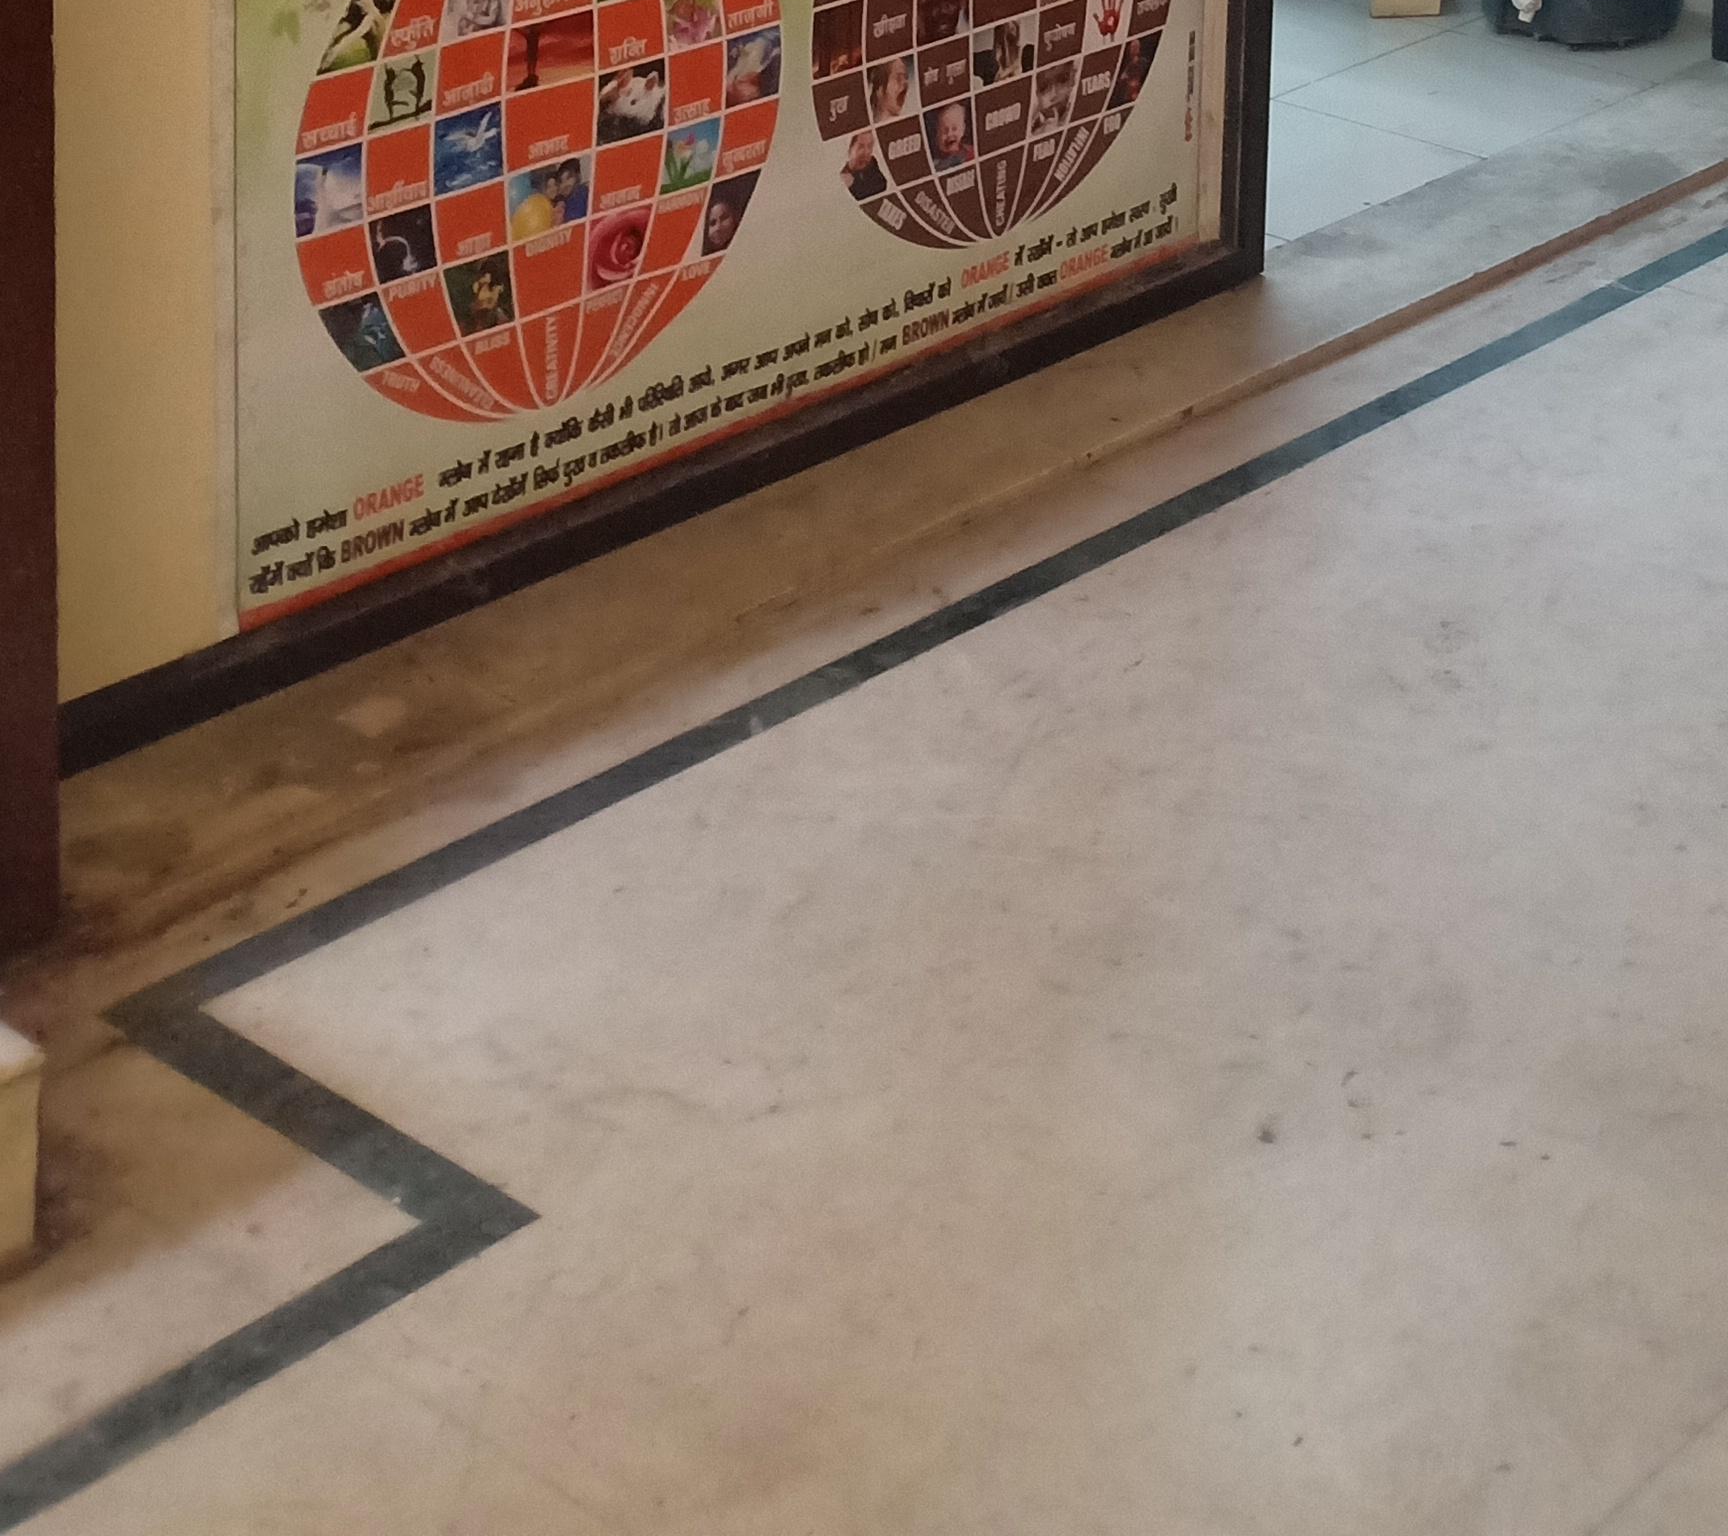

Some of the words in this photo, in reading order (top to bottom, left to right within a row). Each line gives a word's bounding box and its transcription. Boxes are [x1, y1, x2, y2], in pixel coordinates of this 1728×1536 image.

[341, 519, 404, 563] BROWN
[902, 309, 949, 346] BROWN
[1060, 244, 1109, 280] ORANGE
[353, 474, 424, 520] ORANGE
[961, 251, 1010, 289] ORANGE
